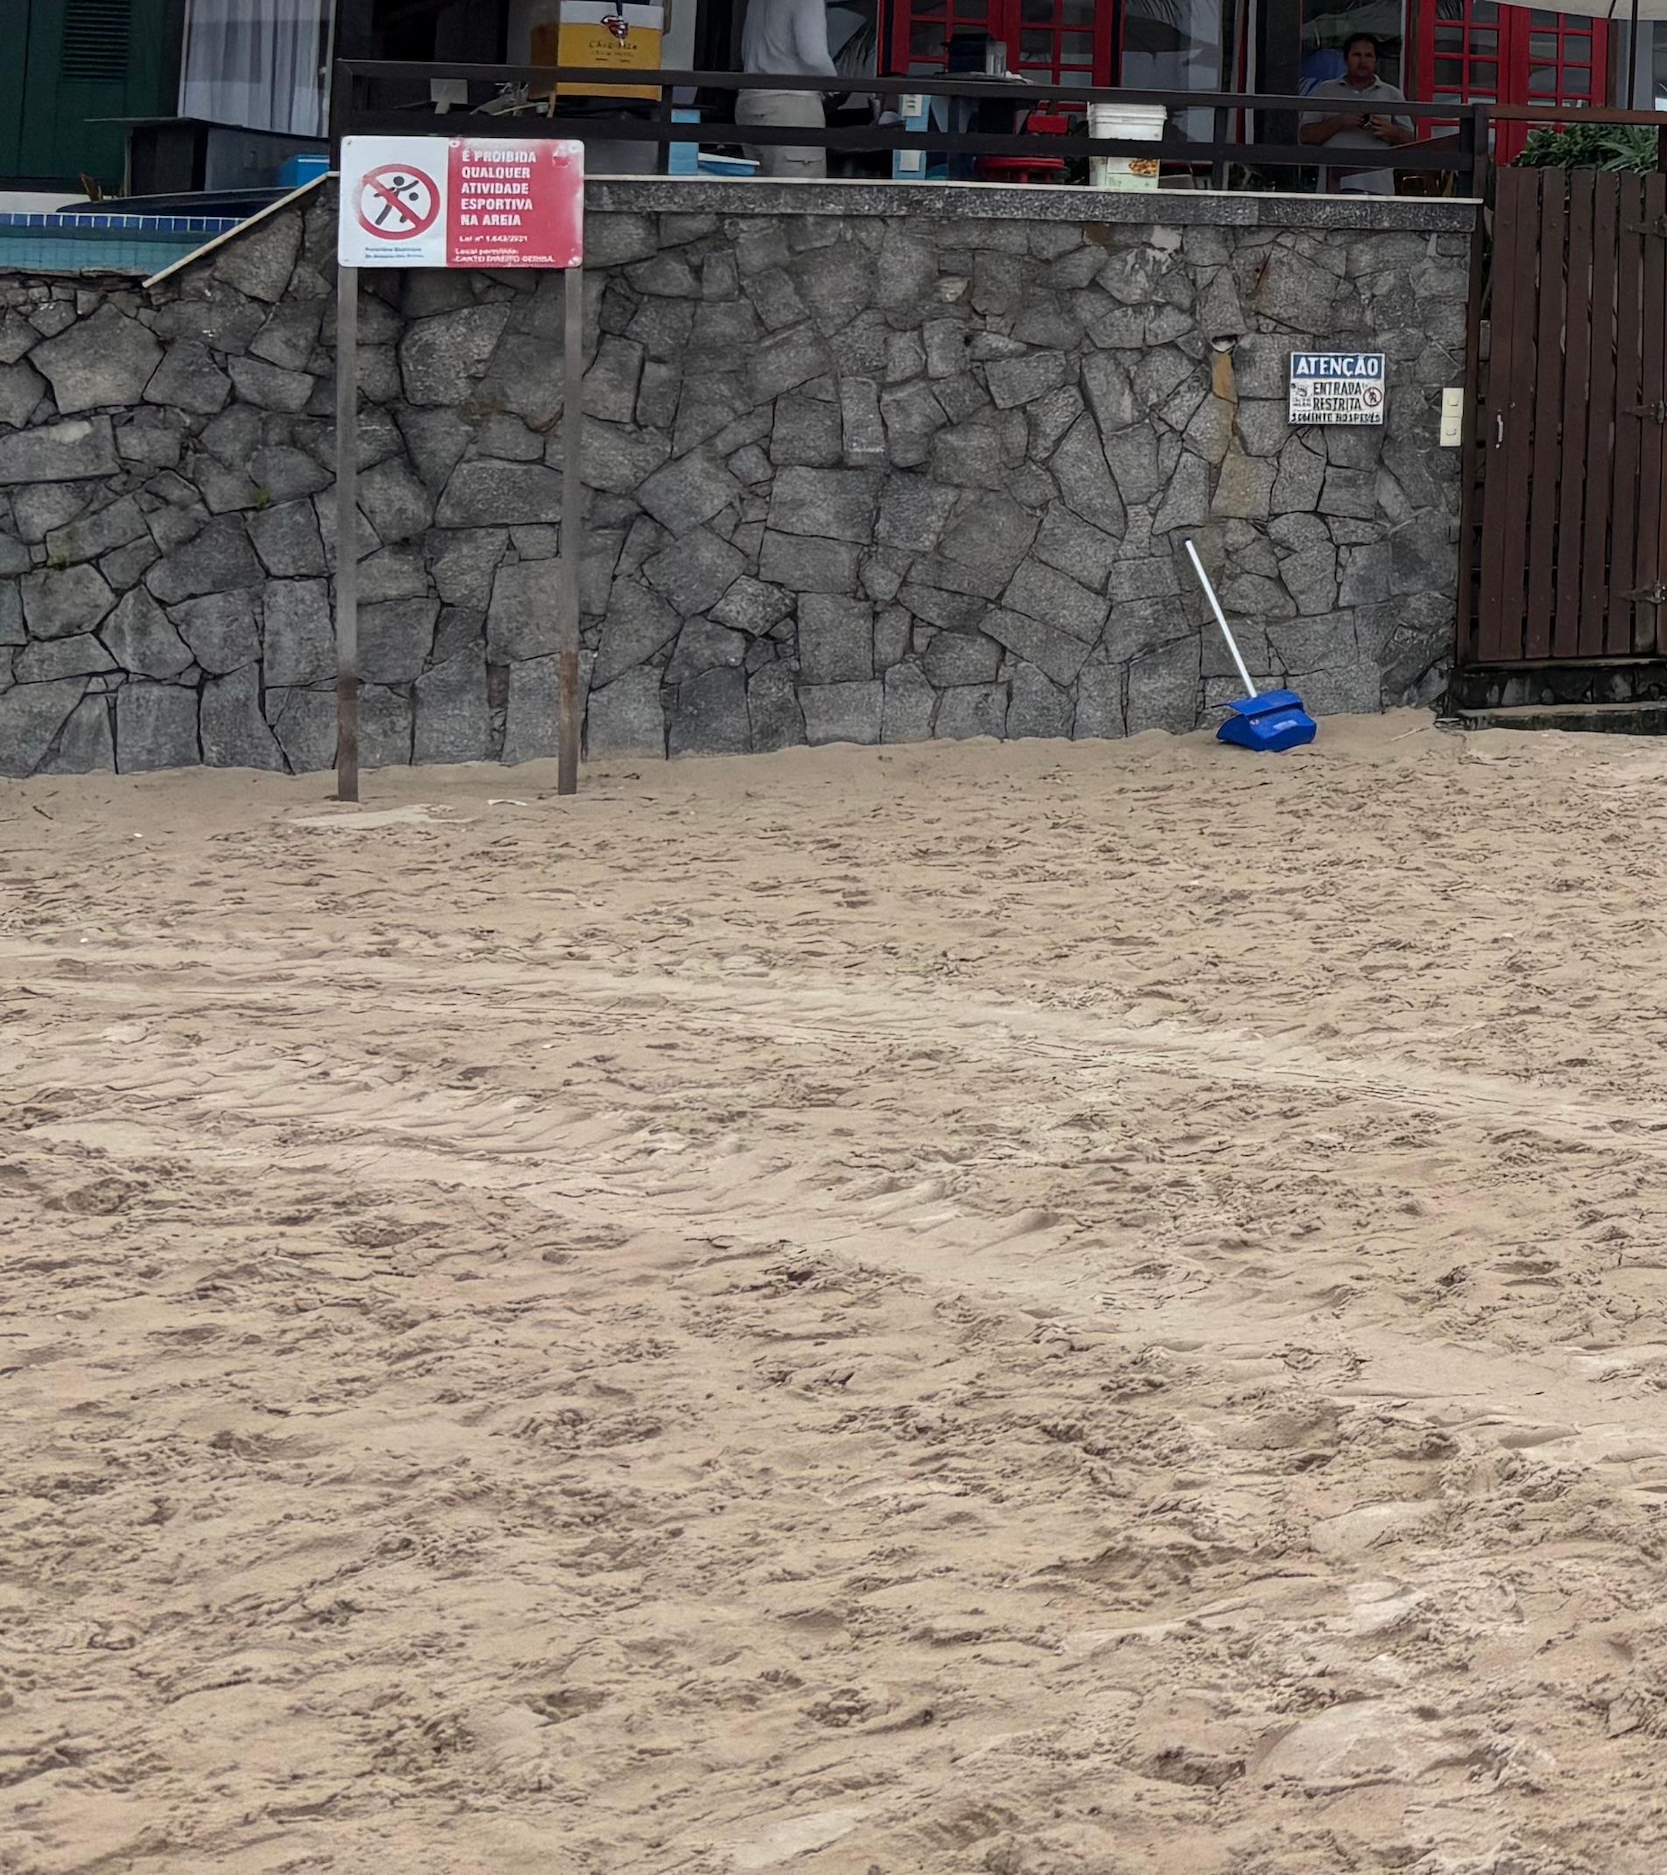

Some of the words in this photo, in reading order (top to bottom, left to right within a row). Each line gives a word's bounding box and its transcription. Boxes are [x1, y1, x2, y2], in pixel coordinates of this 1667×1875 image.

[473, 150, 537, 163] PROIBIDA
[461, 166, 531, 179] QUALQUER
[461, 182, 529, 194] ATIVIDADE
[460, 198, 533, 210] ESPORTIVA
[460, 214, 478, 226] NA
[482, 214, 521, 226] AREIA
[1296, 355, 1379, 377] ATENÇÃO
[1313, 381, 1362, 396] ENTRADA
[1313, 397, 1362, 411] RESTRITA
